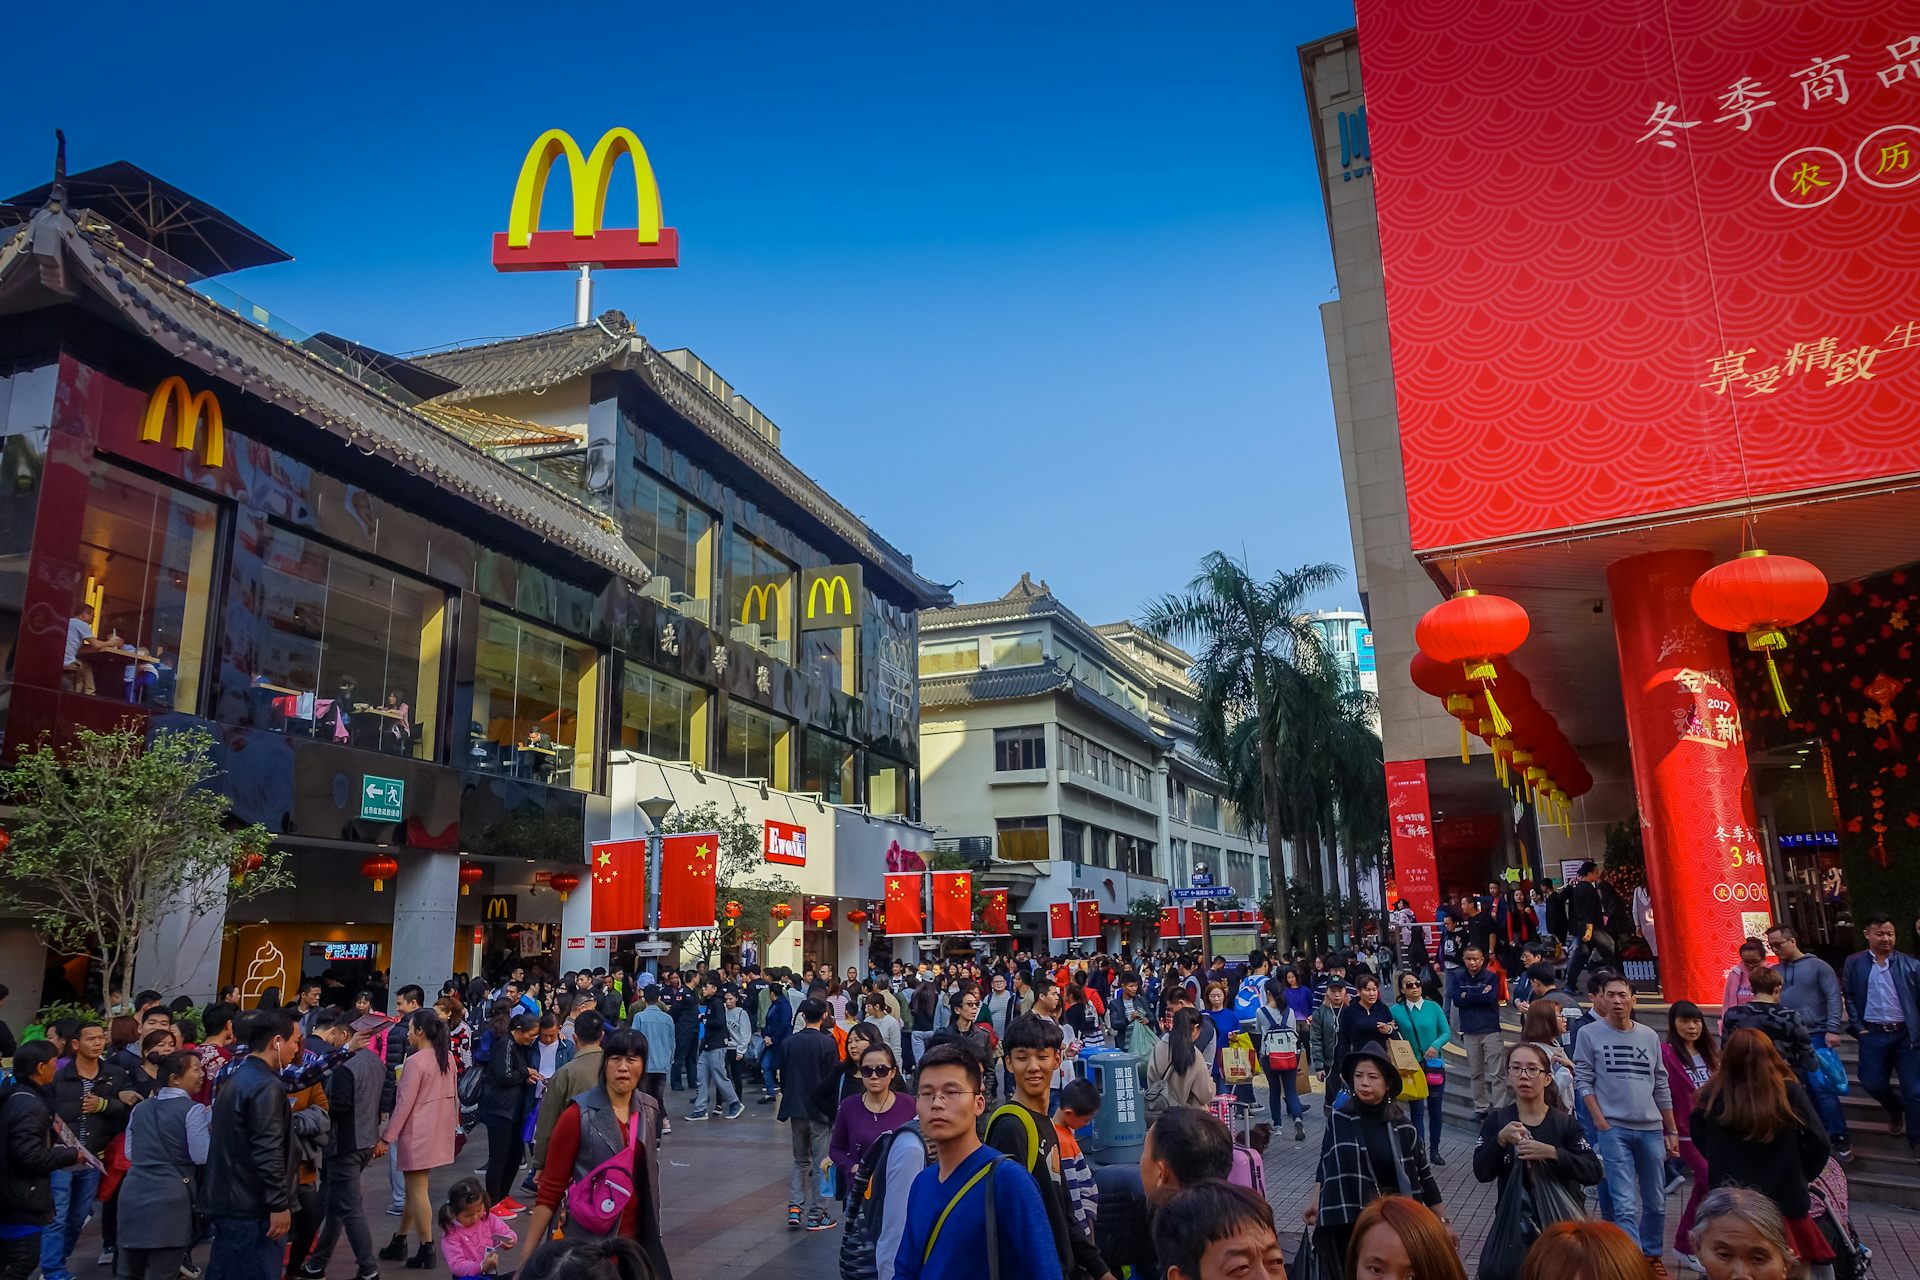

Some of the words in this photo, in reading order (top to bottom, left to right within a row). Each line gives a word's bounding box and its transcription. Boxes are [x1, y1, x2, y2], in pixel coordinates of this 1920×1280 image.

[1636, 35, 1920, 149] 冬季商品
[1707, 699, 1730, 713] 2017
[1115, 1068, 1127, 1123] 深圳更美丽
[1124, 1067, 1136, 1122] 垃圾不落地
